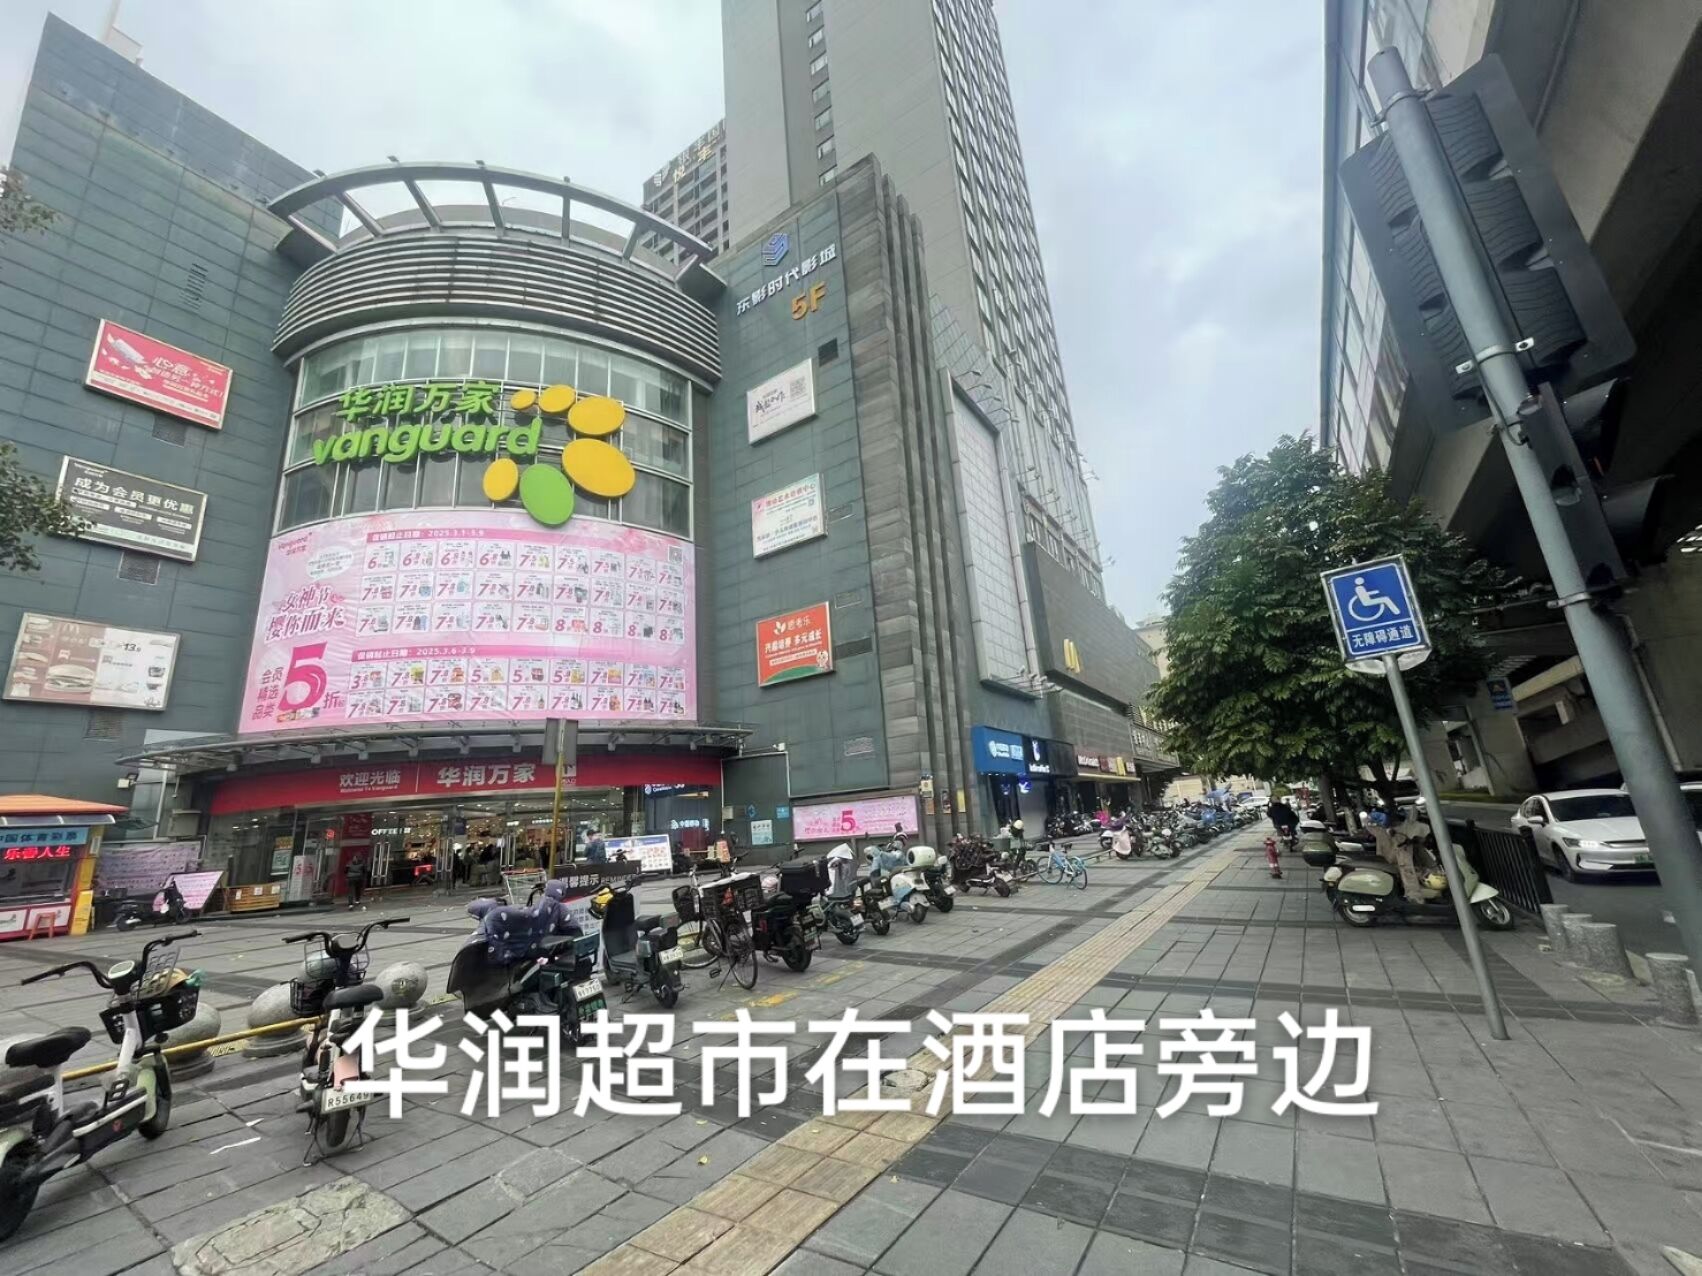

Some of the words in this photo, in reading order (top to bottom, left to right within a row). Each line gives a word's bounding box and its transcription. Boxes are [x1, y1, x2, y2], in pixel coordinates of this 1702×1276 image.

[791, 281, 826, 320] 5F
[337, 381, 500, 422] 华润万家
[313, 416, 543, 465] vanguard
[74, 477, 194, 515] 成为会员更优惠
[1352, 625, 1413, 649] 无障碍通道
[278, 641, 328, 713] 5
[340, 770, 400, 788] 欢迎光临
[437, 763, 536, 788] 华润万家
[841, 810, 856, 832] 5
